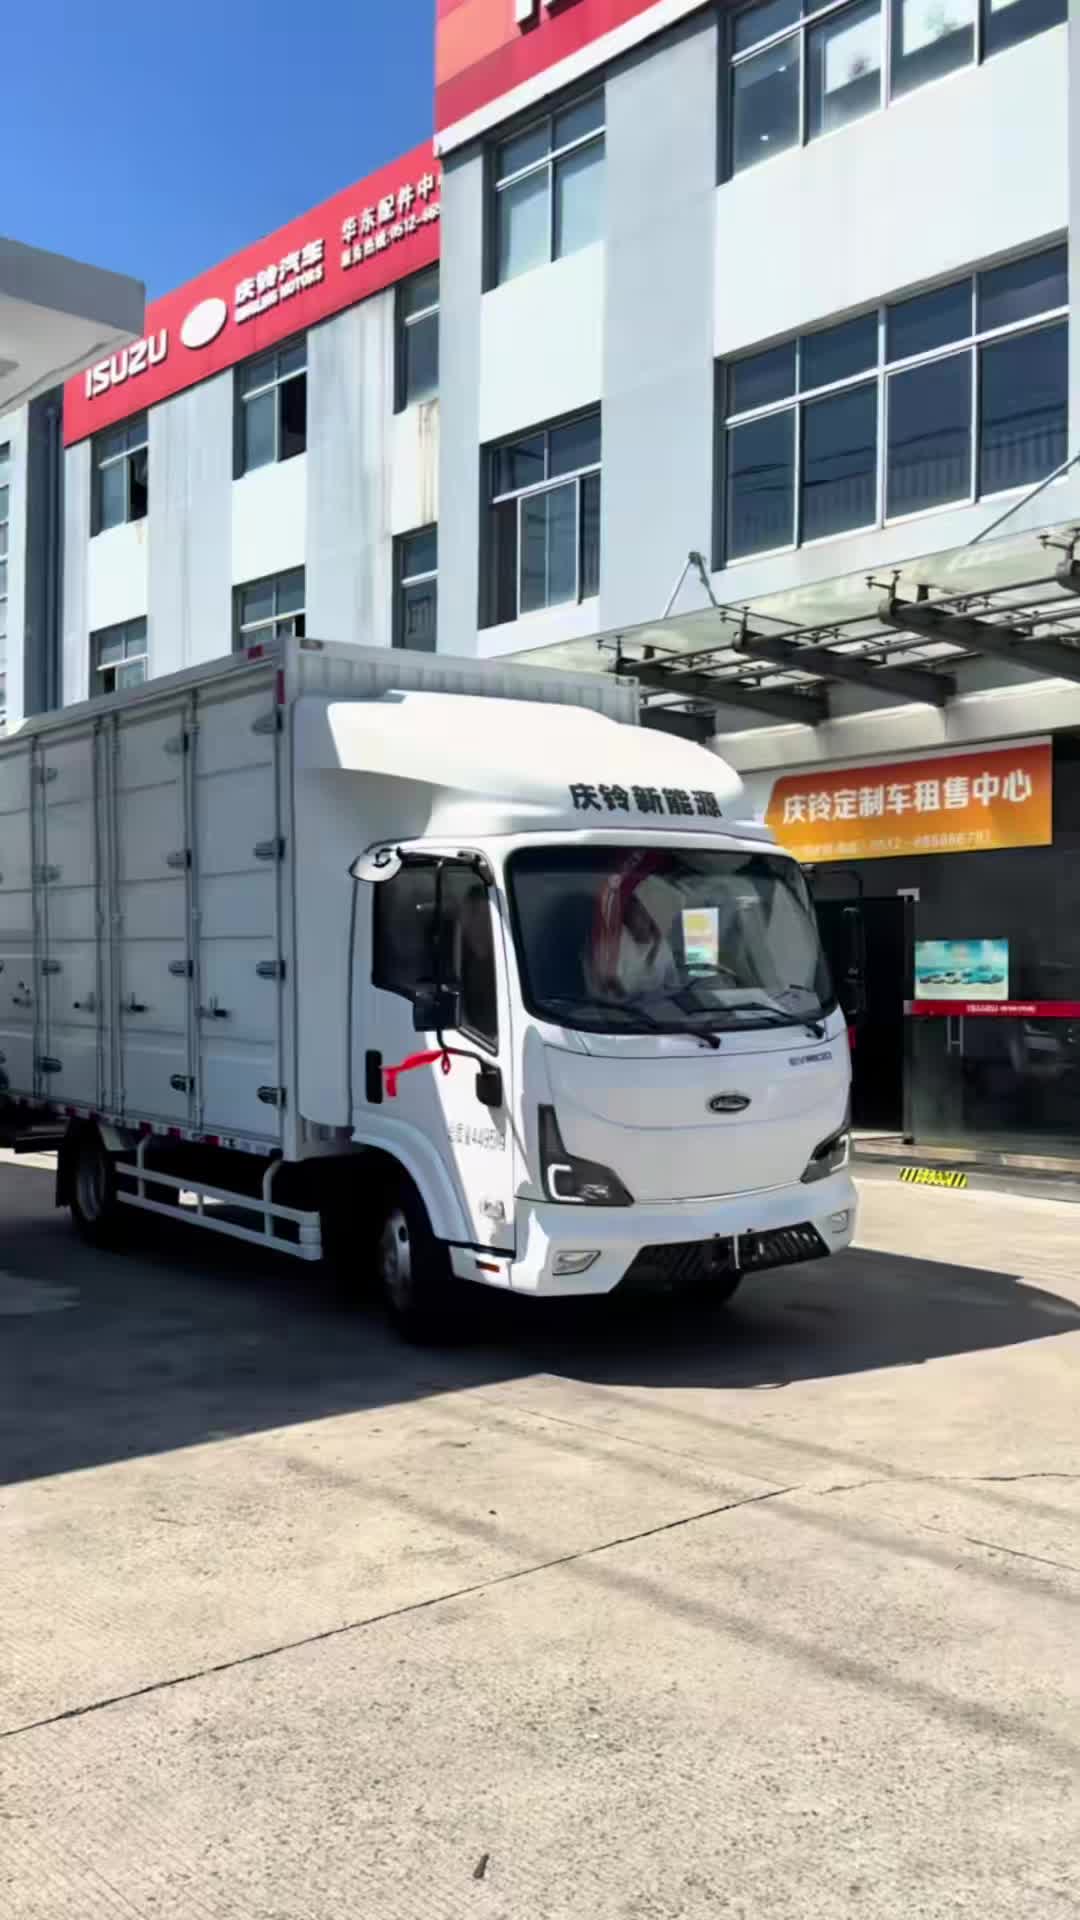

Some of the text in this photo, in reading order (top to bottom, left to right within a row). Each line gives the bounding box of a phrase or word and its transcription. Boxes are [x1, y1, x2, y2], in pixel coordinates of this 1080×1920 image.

[342, 172, 442, 243] 华东配件中
[235, 238, 324, 307] 庆铃汽车
[85, 328, 168, 399] ISUZU
[568, 783, 723, 817] 庆铃新能源
[783, 769, 1033, 824] 庆铃定制车租售中心
